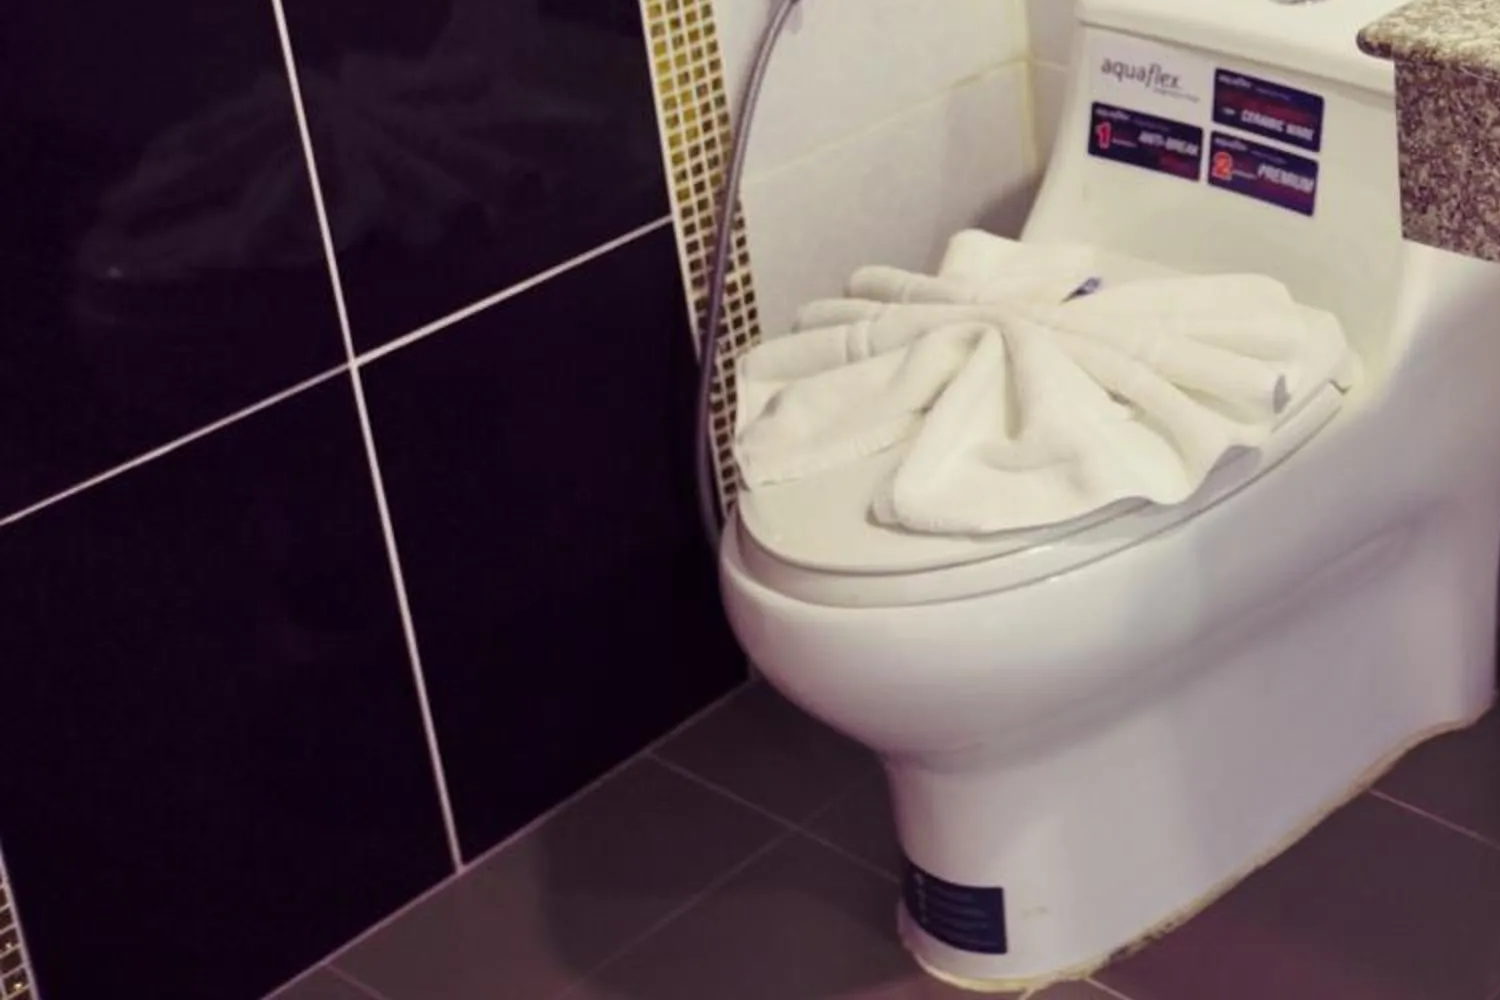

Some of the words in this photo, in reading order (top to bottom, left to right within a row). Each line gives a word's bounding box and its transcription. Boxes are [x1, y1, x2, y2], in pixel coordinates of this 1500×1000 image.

[1101, 57, 1181, 88] aquaflex
[1096, 121, 1111, 149] 1
[1212, 151, 1233, 181] 2
